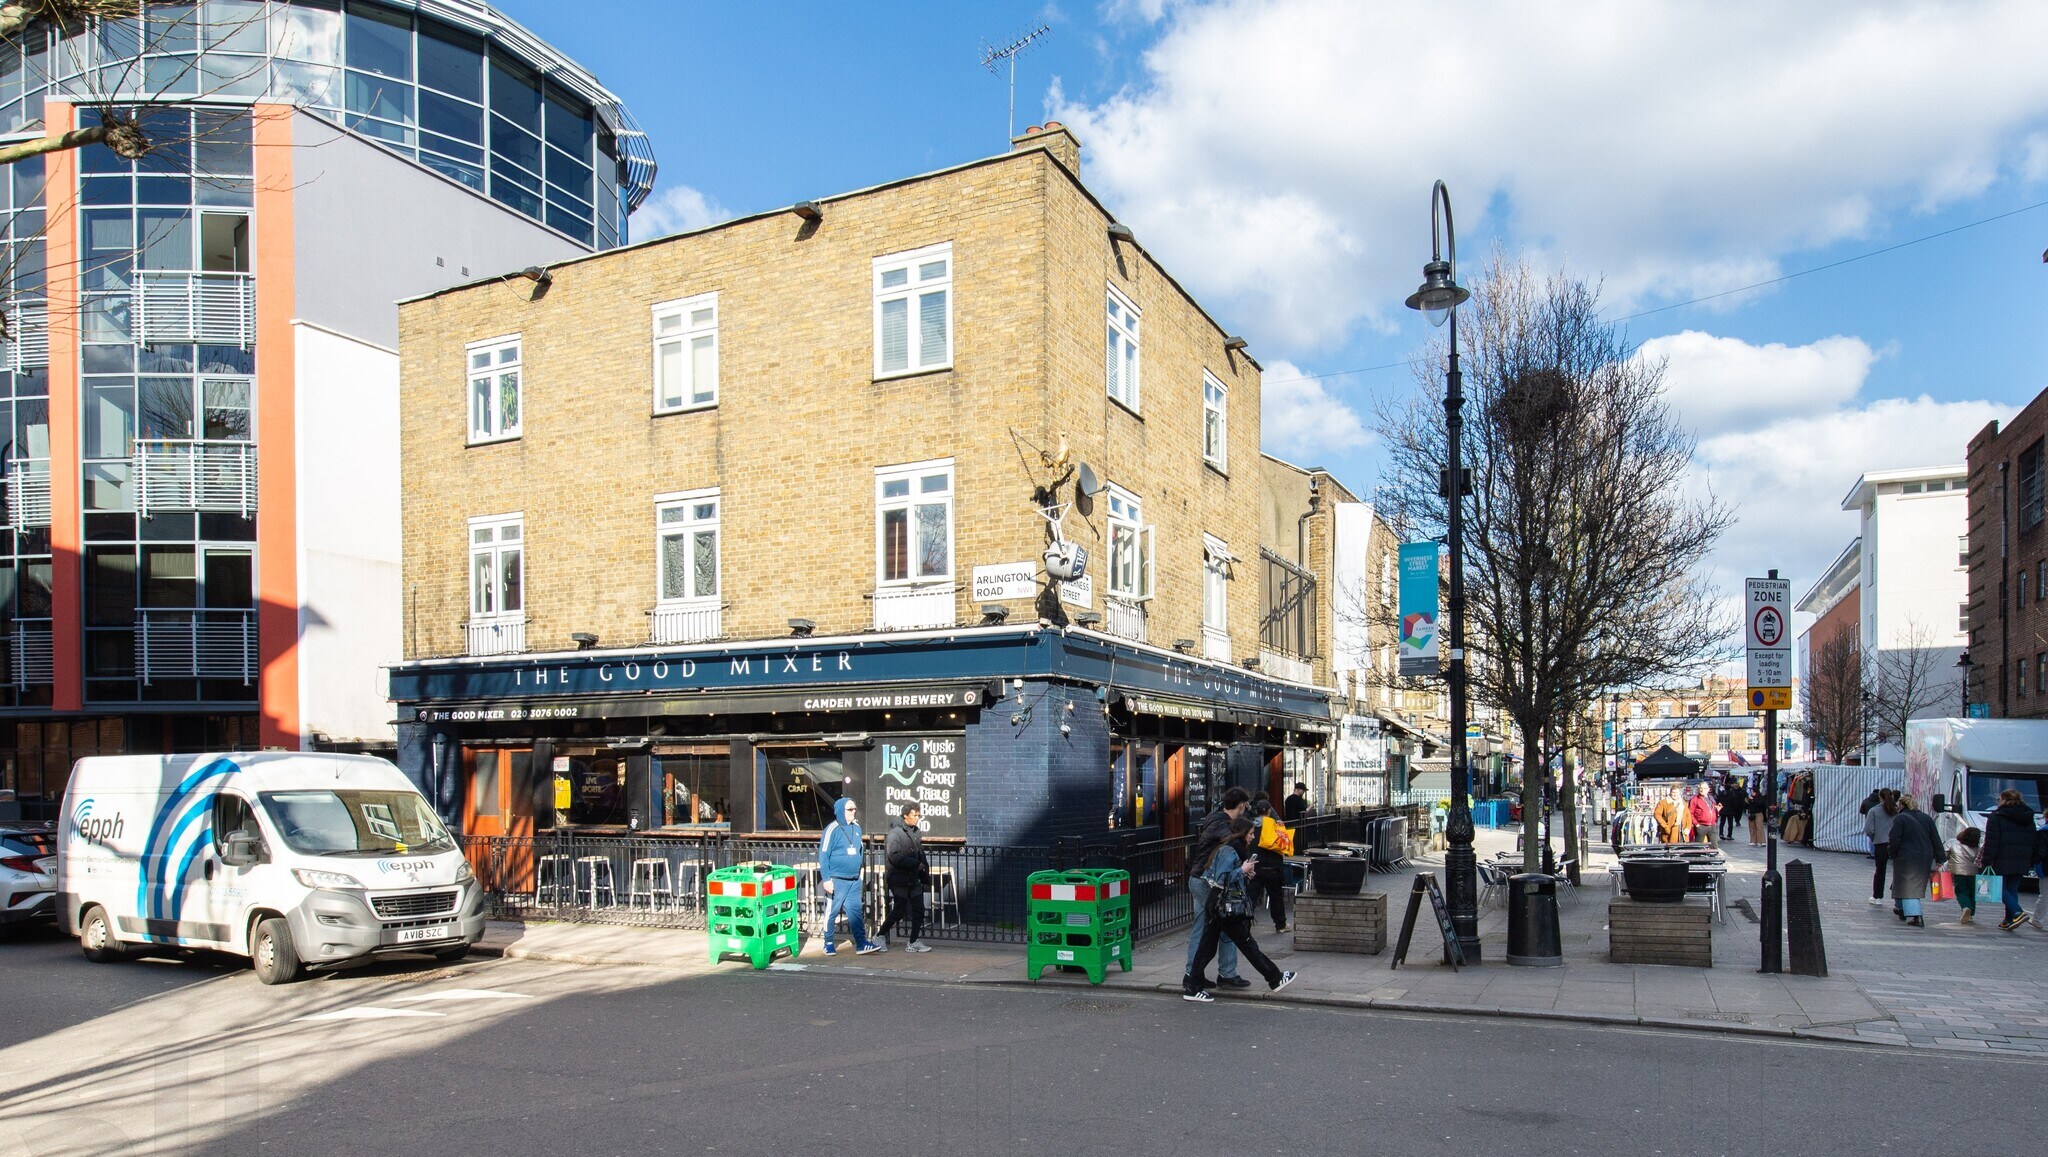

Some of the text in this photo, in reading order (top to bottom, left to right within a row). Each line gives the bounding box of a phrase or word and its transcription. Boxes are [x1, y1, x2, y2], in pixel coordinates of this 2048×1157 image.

[976, 572, 1031, 585] ARLINGTON
[1748, 581, 1788, 589] PEDESTRIAN
[976, 587, 1004, 597] ROAD
[1062, 588, 1080, 601] STREET
[1754, 591, 1782, 602] ZONE
[1754, 652, 1774, 660] Except
[513, 651, 852, 686] THE GOOD MIXER
[1163, 664, 1191, 686] THE
[1204, 673, 1240, 695] GOOD
[804, 694, 955, 709] CAMDEN TOWN BREWERY
[1137, 701, 1148, 711] THE
[1149, 703, 1164, 713] GOOD
[434, 708, 578, 720] THE GOOD MIXER 020 3076 0002
[879, 743, 921, 786] Live
[1343, 759, 1382, 769] nemesis
[585, 776, 598, 785] LIVE
[582, 785, 601, 793] SPORTS
[788, 785, 808, 793] CRAFT
[79, 811, 124, 845] epph
[389, 860, 435, 873] epph
[403, 928, 443, 940] AV18 SZC
